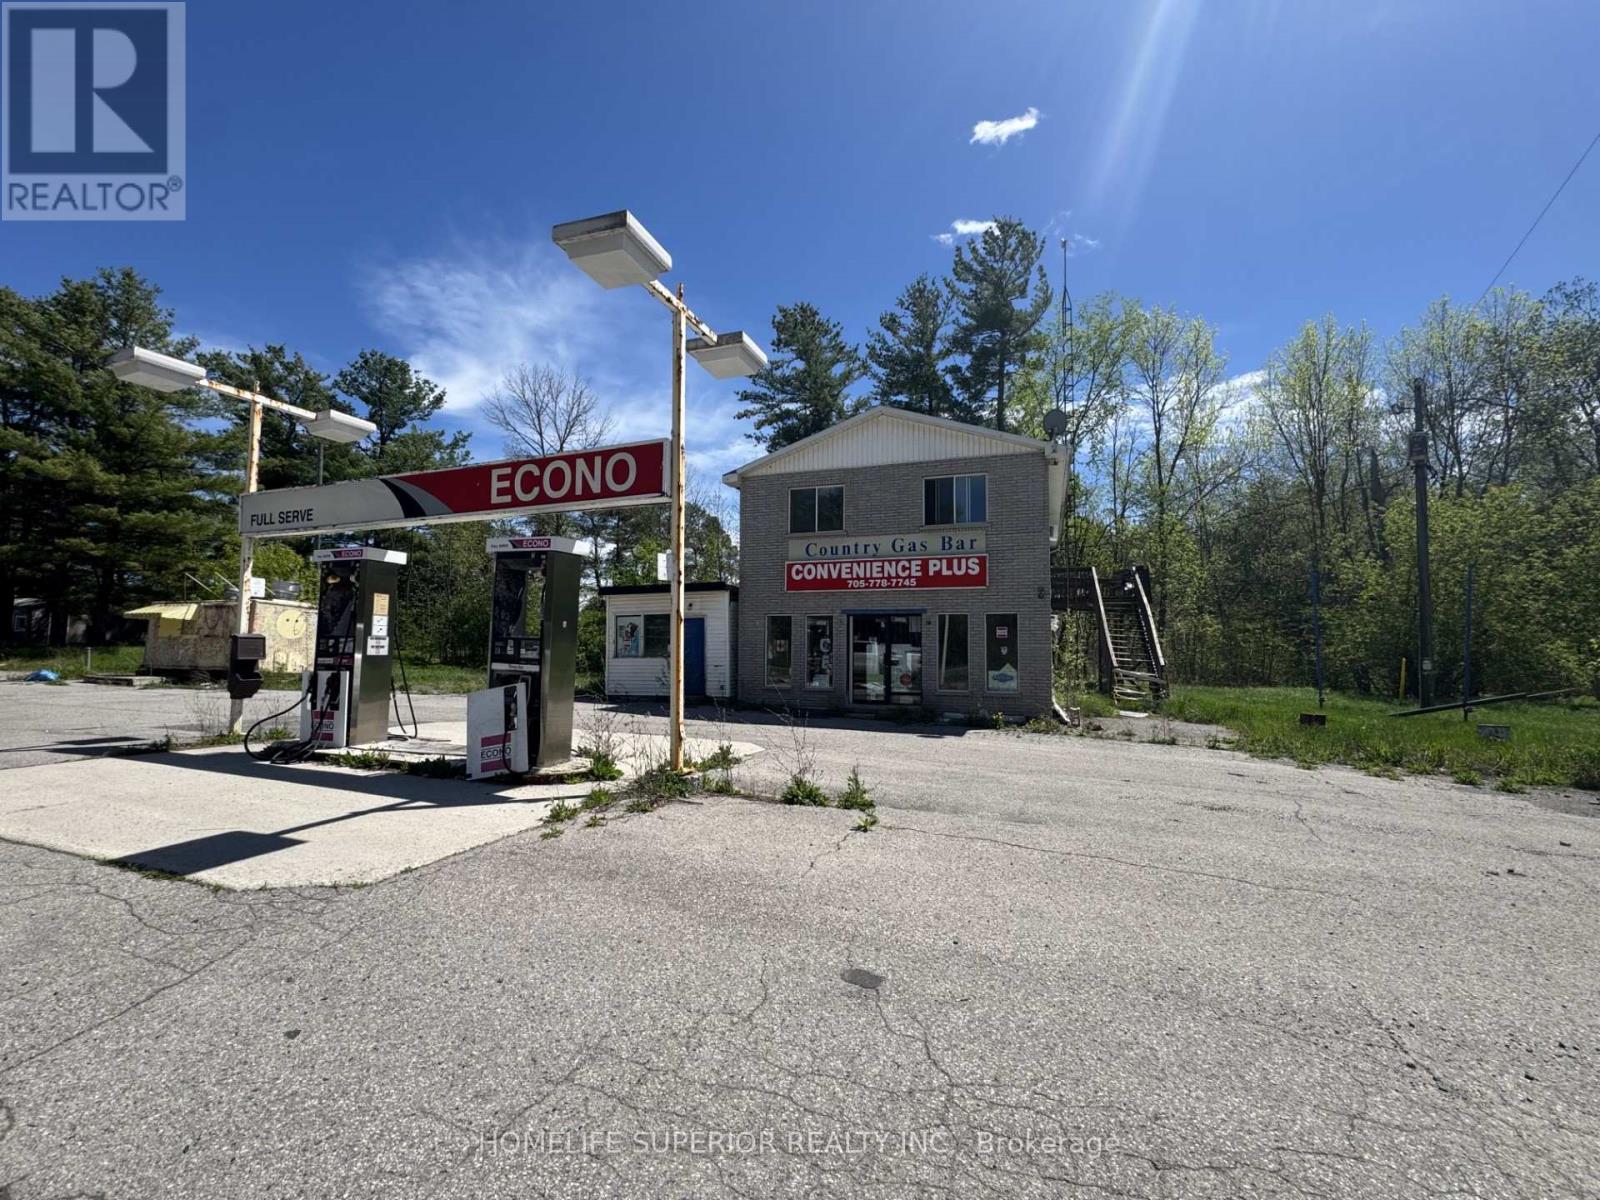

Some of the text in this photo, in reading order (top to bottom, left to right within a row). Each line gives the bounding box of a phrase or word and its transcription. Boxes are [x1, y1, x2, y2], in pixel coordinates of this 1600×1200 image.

[490, 452, 637, 504] ECONO
[250, 508, 314, 527] FULL SERVE
[522, 539, 549, 548] ECONO
[805, 535, 977, 557] Country Gas Bar
[791, 558, 980, 581] CONVENIENCE PLUS
[847, 578, 917, 588] 705-778-7745
